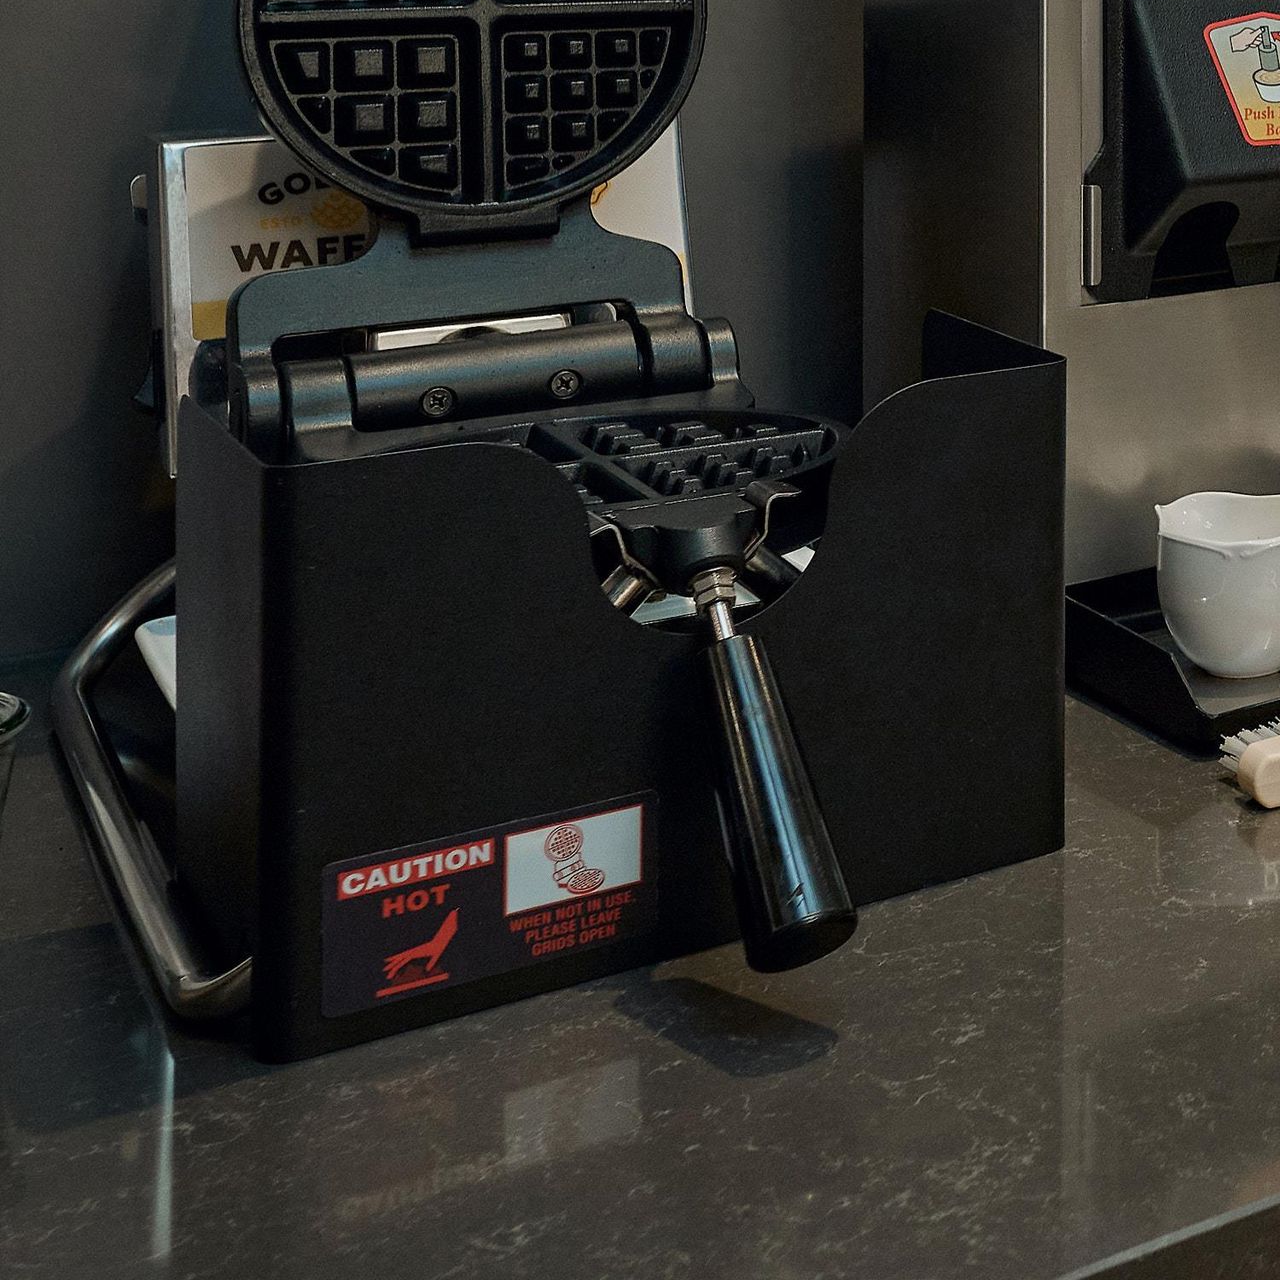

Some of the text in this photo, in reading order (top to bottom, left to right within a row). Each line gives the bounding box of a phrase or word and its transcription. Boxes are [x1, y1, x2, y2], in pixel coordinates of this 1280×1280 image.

[1244, 106, 1274, 120] Push
[341, 841, 491, 896] CAUTION
[381, 883, 450, 918] HOT
[510, 911, 552, 933] WHEN
[556, 902, 584, 921] NOT
[587, 898, 601, 911] IN
[525, 908, 622, 944] PLEASE LEAVE
[531, 924, 616, 957] GRIDS OPEN
